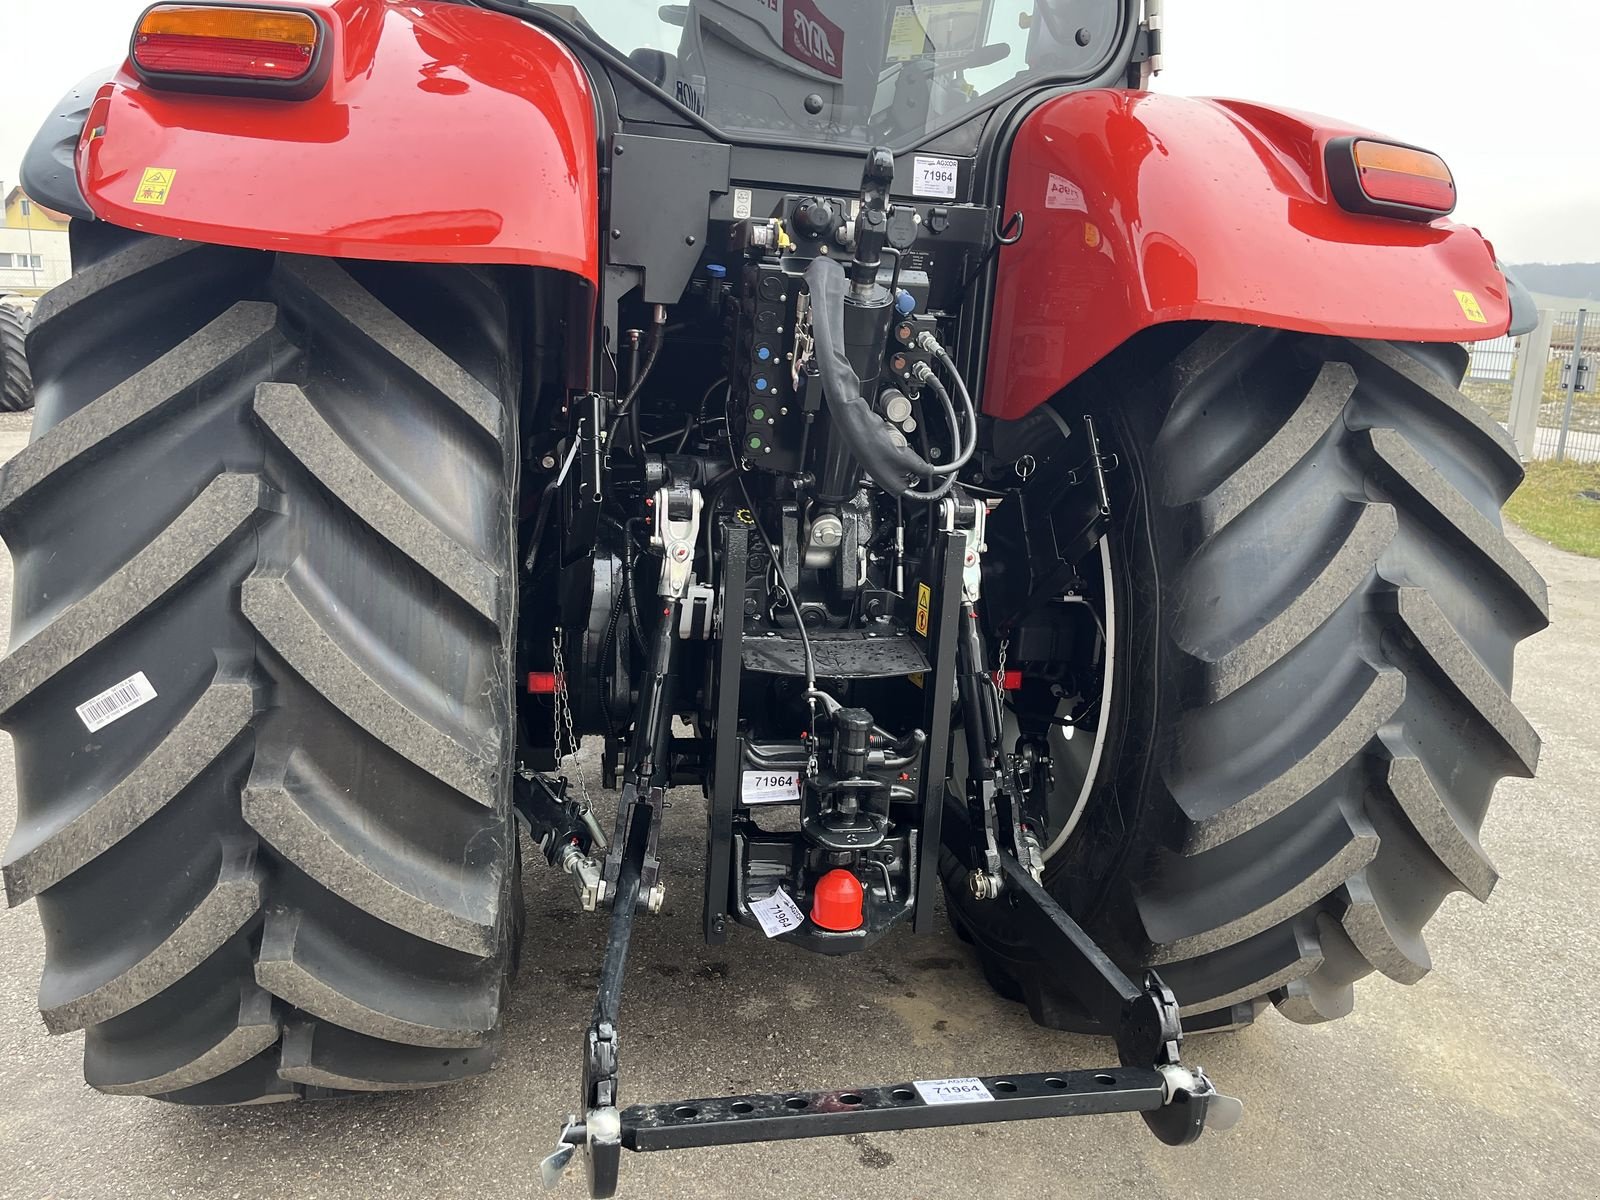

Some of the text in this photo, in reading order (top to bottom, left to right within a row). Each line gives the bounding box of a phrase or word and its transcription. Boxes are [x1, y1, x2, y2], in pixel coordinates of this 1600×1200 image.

[924, 169, 953, 182] 71964
[755, 776, 793, 787] 71964
[769, 904, 792, 928] 71964
[932, 1085, 980, 1094] 71964
